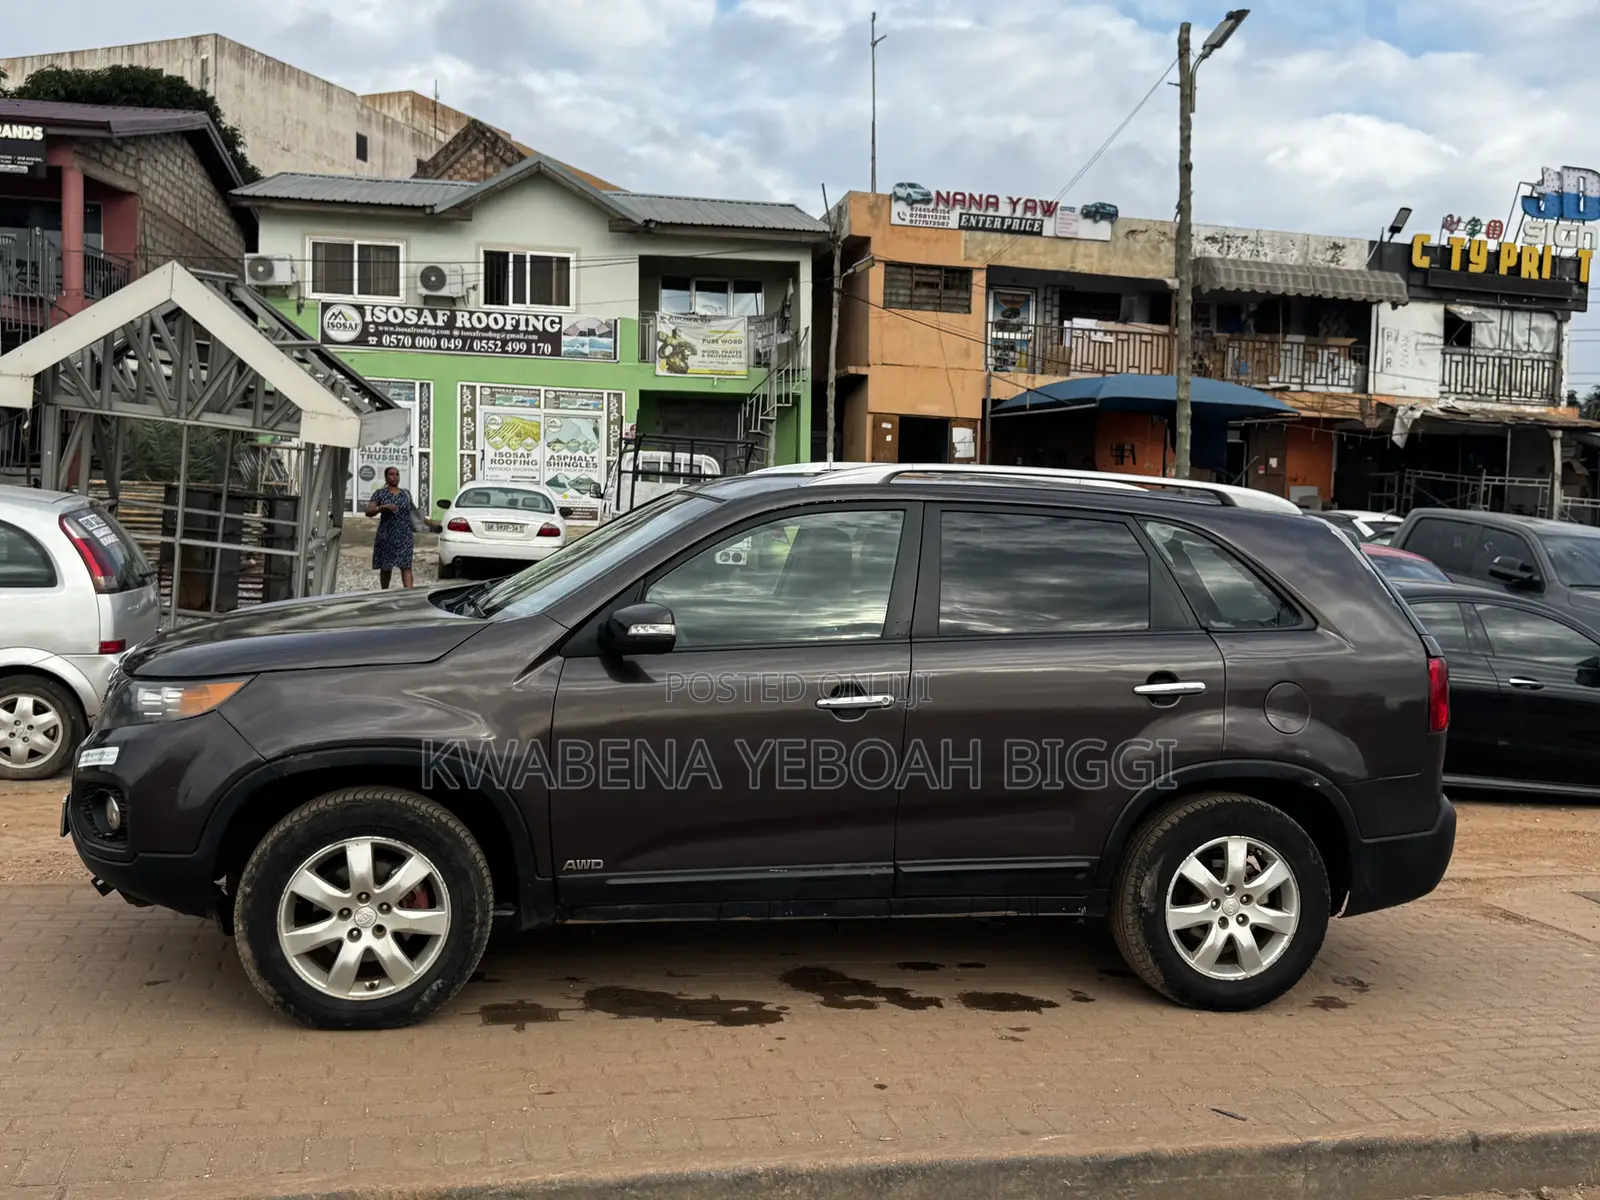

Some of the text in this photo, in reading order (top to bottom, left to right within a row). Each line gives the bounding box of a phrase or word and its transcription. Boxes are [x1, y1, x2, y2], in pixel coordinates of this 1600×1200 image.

[0, 124, 44, 141] ANDS
[935, 190, 1059, 218] NANA YAW
[960, 214, 1042, 232] ENTERPRICE
[1411, 234, 1593, 283] CTY PRIT
[363, 305, 561, 333] ISOSAF ROOFING
[326, 320, 361, 331] ISOSAF
[382, 333, 412, 348] 0570
[414, 336, 437, 349] 000
[440, 338, 463, 351] 049
[473, 338, 501, 353] 0552
[505, 341, 527, 354] 499
[531, 343, 551, 355] 170
[360, 446, 408, 455] ALUZINC
[494, 451, 532, 459] ISOSAF
[490, 458, 538, 466] ROOFING
[549, 454, 596, 462] ASPHALT
[546, 460, 598, 469] SHINGLES
[562, 859, 604, 870] AWD
